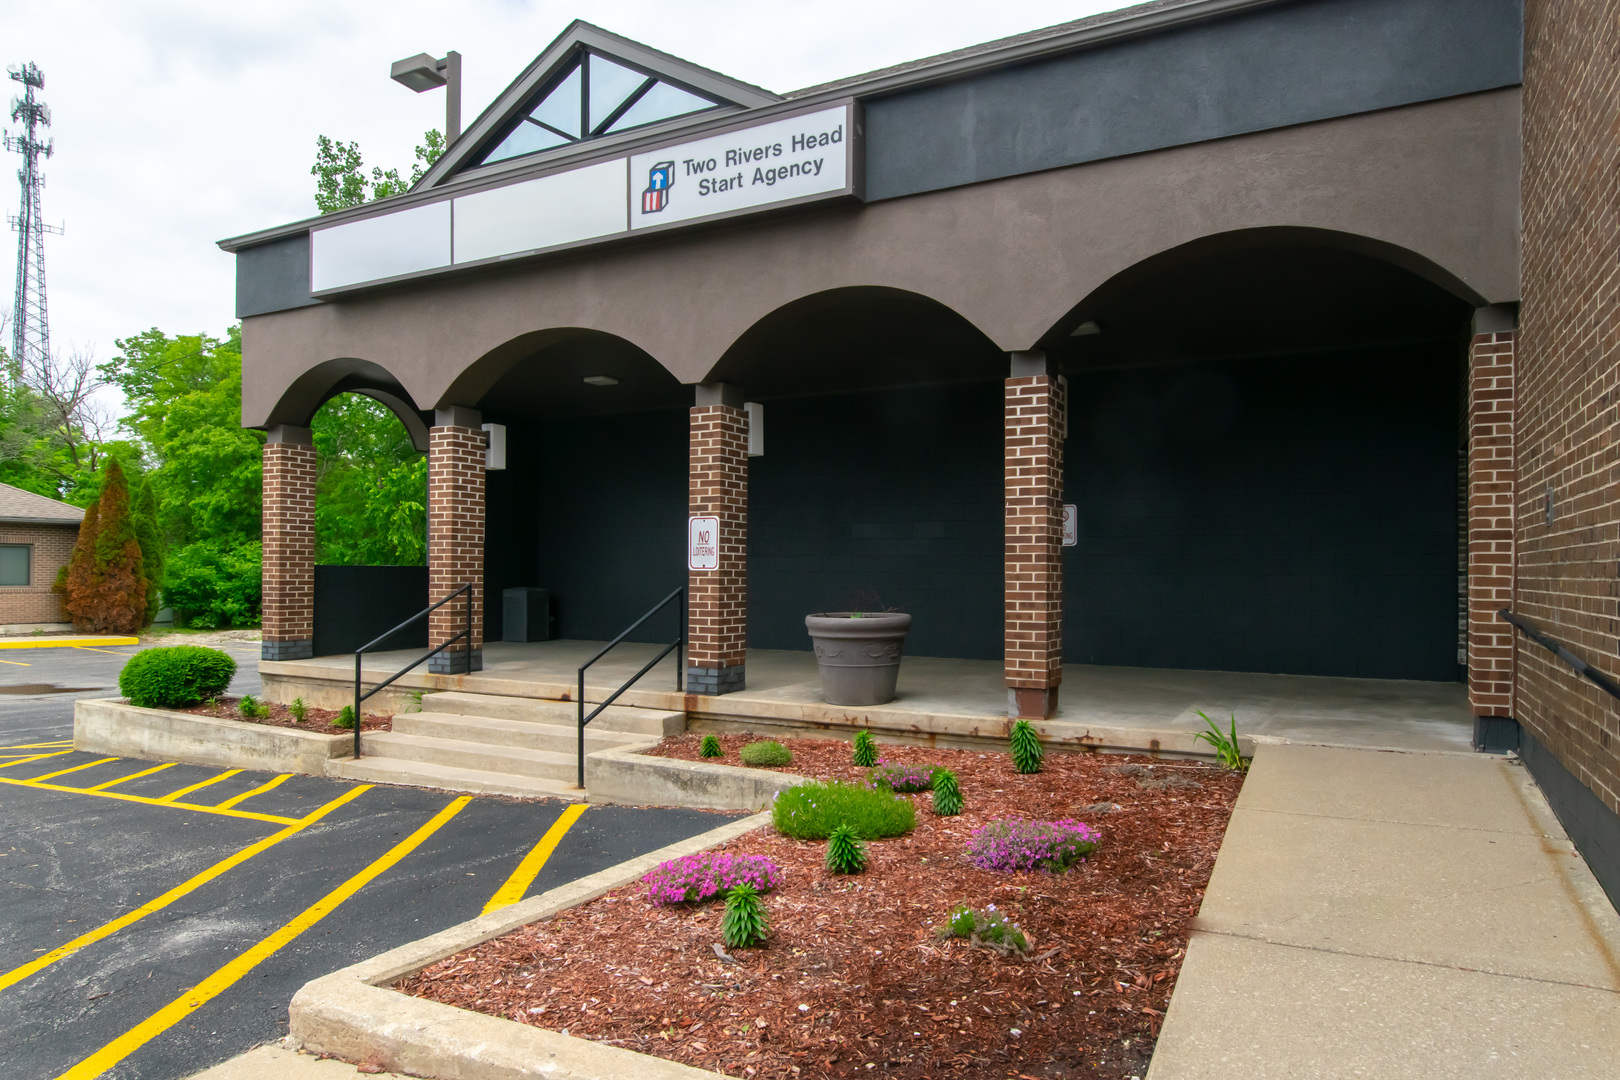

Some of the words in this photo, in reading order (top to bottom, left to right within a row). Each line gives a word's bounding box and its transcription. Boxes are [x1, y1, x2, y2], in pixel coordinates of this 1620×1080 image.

[683, 158, 717, 176] Two
[725, 143, 783, 168] Rivers
[791, 124, 843, 153] Head
[698, 173, 744, 196] Start
[751, 158, 824, 186] Agency
[698, 530, 710, 543] NO
[693, 546, 715, 556] LOITERING
